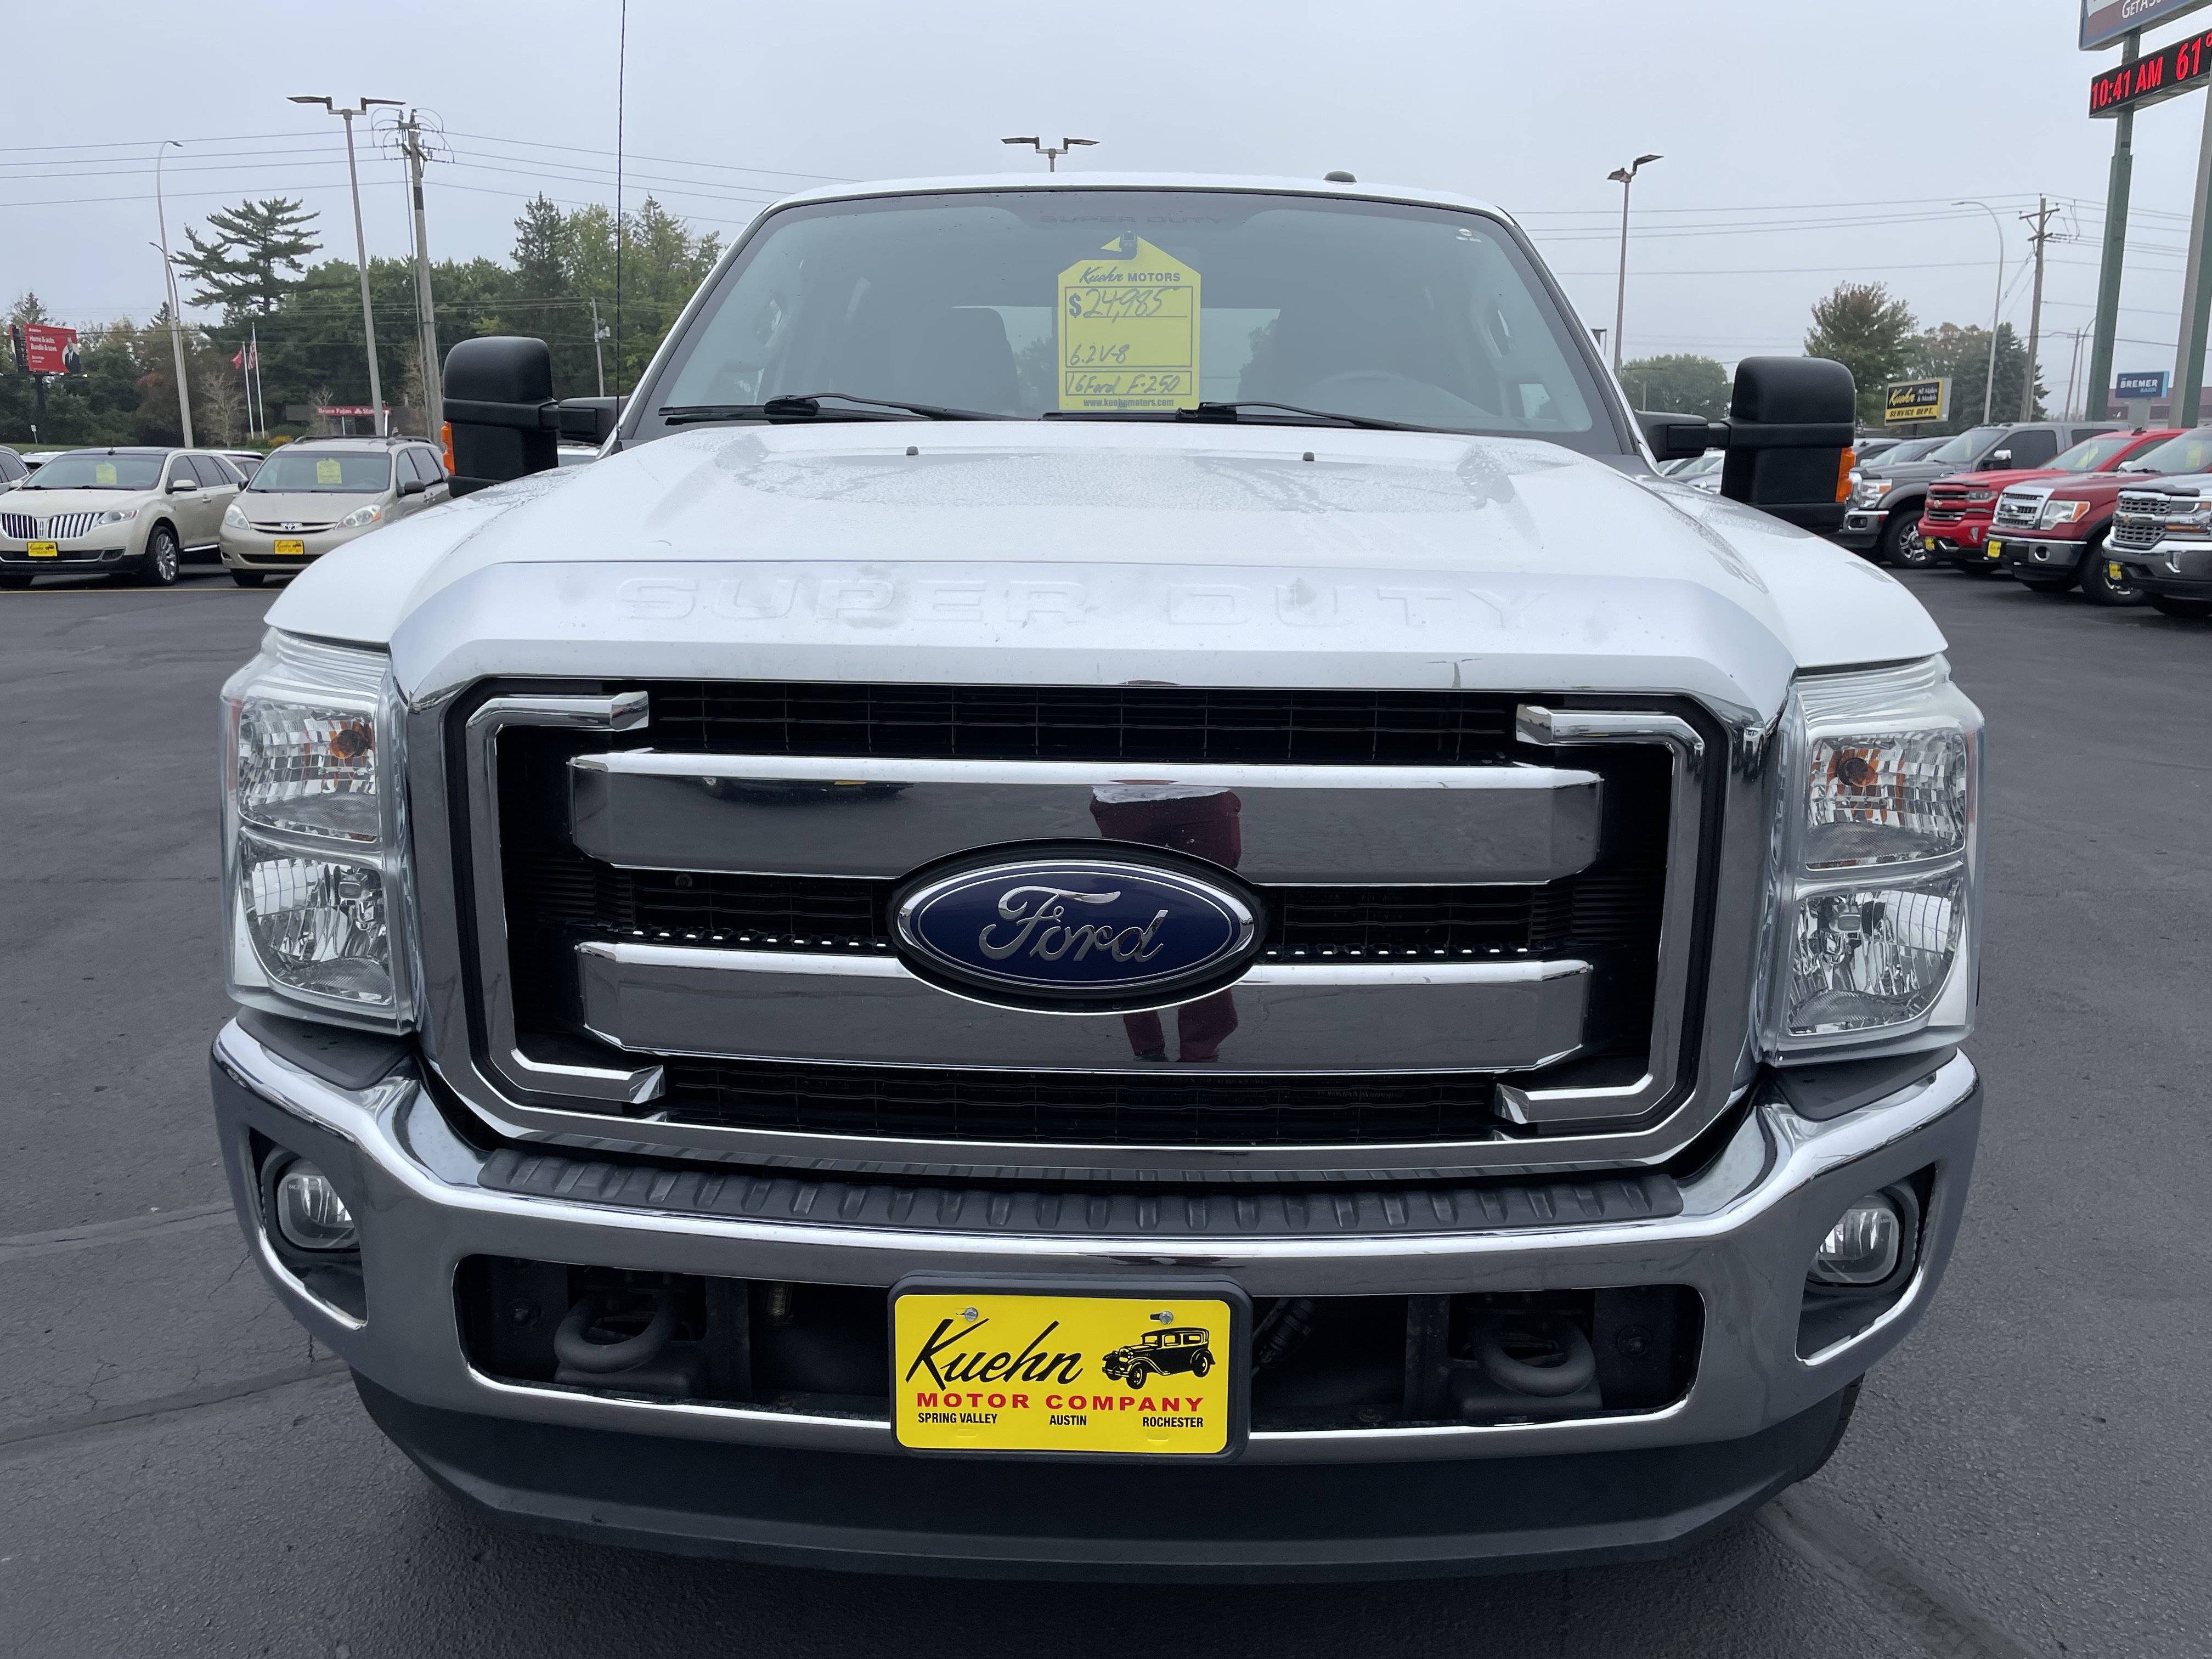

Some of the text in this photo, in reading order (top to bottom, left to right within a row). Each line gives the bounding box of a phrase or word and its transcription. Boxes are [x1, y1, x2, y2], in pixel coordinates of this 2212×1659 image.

[2092, 70, 2130, 109] 10:41
[2135, 57, 2163, 93] AM
[1079, 266, 1181, 284] Kuehn MOTORS
[2120, 379, 2158, 388] BREMER
[1889, 409, 1914, 417] SERVICE
[617, 578, 1551, 629] SUPER DUTY
[978, 885, 1169, 962] Ford
[905, 1318, 1084, 1391] Kuehn
[917, 1392, 1204, 1412] MOTOR COMPANY
[918, 1412, 997, 1424] SPRING VALLEY
[1049, 1415, 1087, 1426] AUSTIN
[1142, 1416, 1203, 1427] ROCHESTER
